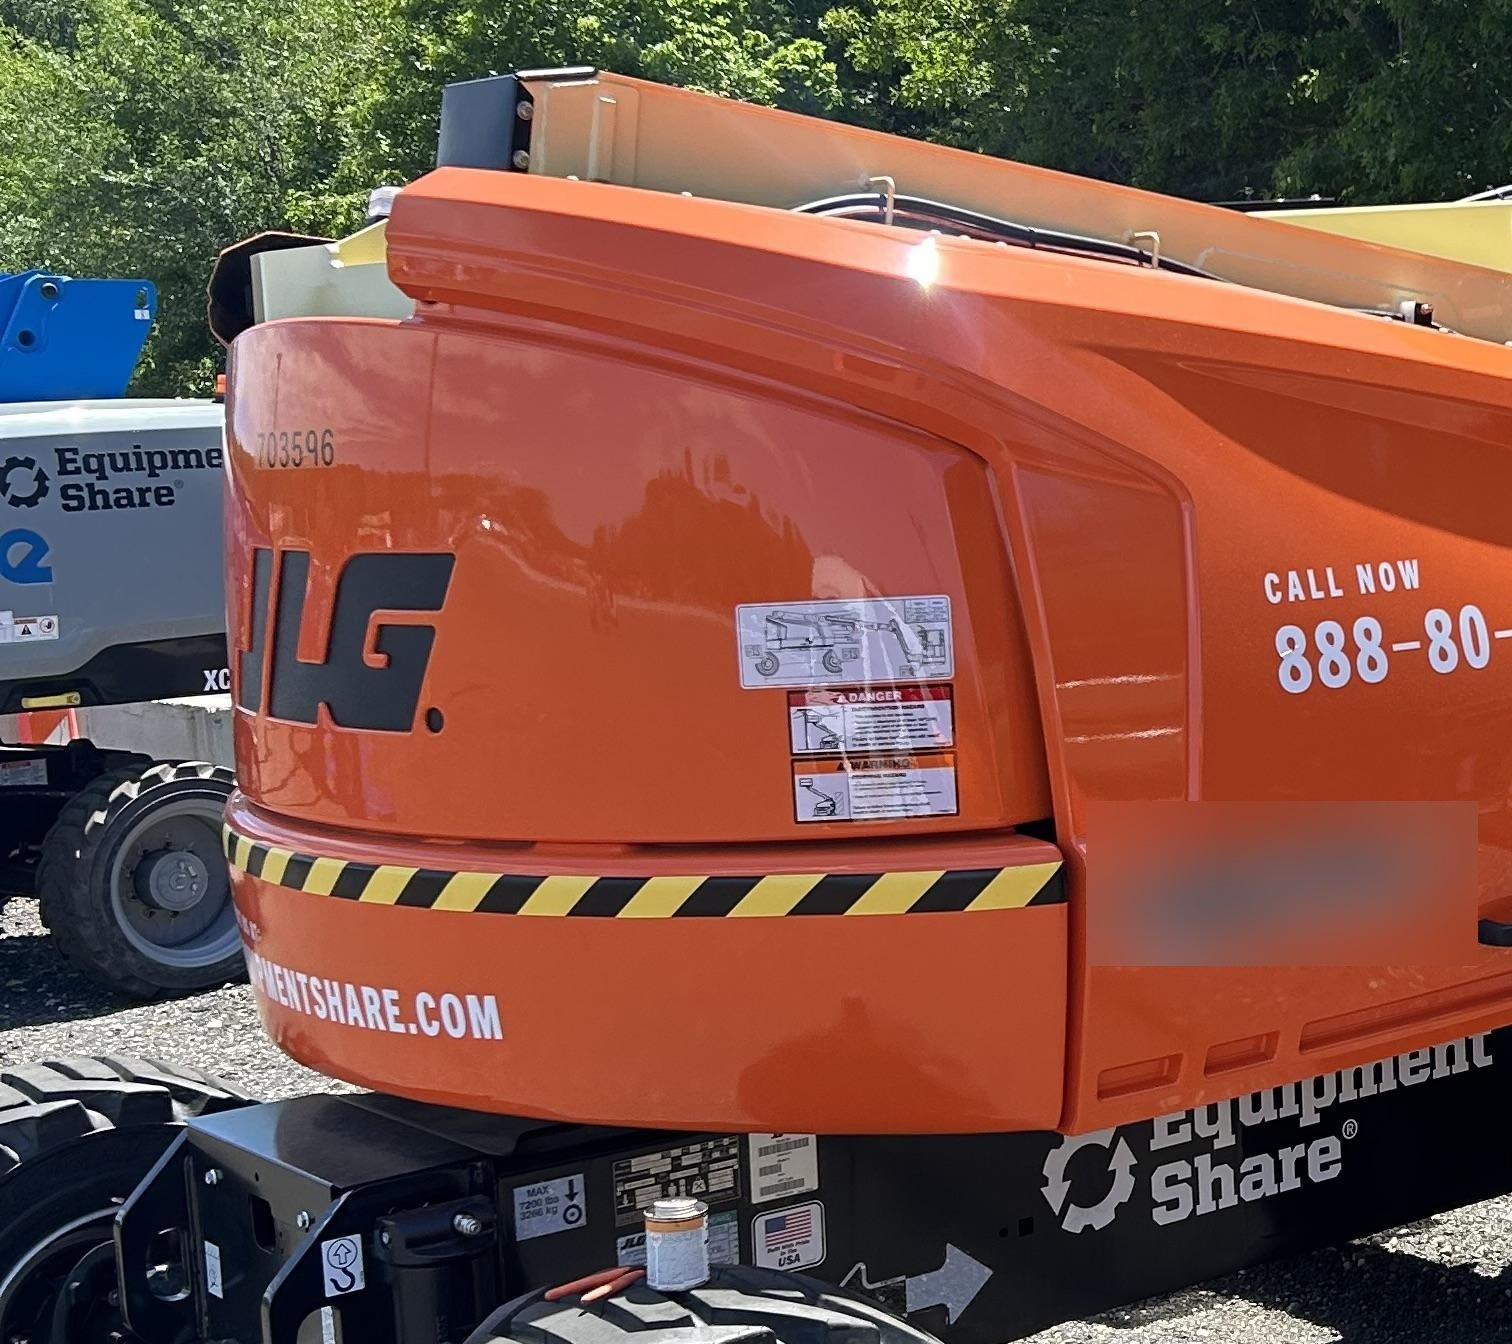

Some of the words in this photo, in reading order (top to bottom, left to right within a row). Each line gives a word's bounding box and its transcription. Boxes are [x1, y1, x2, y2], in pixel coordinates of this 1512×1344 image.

[257, 429, 334, 468] 703596
[54, 445, 222, 480] Equipme
[1264, 567, 1344, 604] CALL
[1355, 559, 1420, 595] NOW
[850, 691, 902, 703] DANGER
[850, 758, 911, 770] WARNING
[1150, 1030, 1493, 1151] Equipment
[526, 1185, 549, 1197] MAX
[778, 1254, 800, 1267] USA
